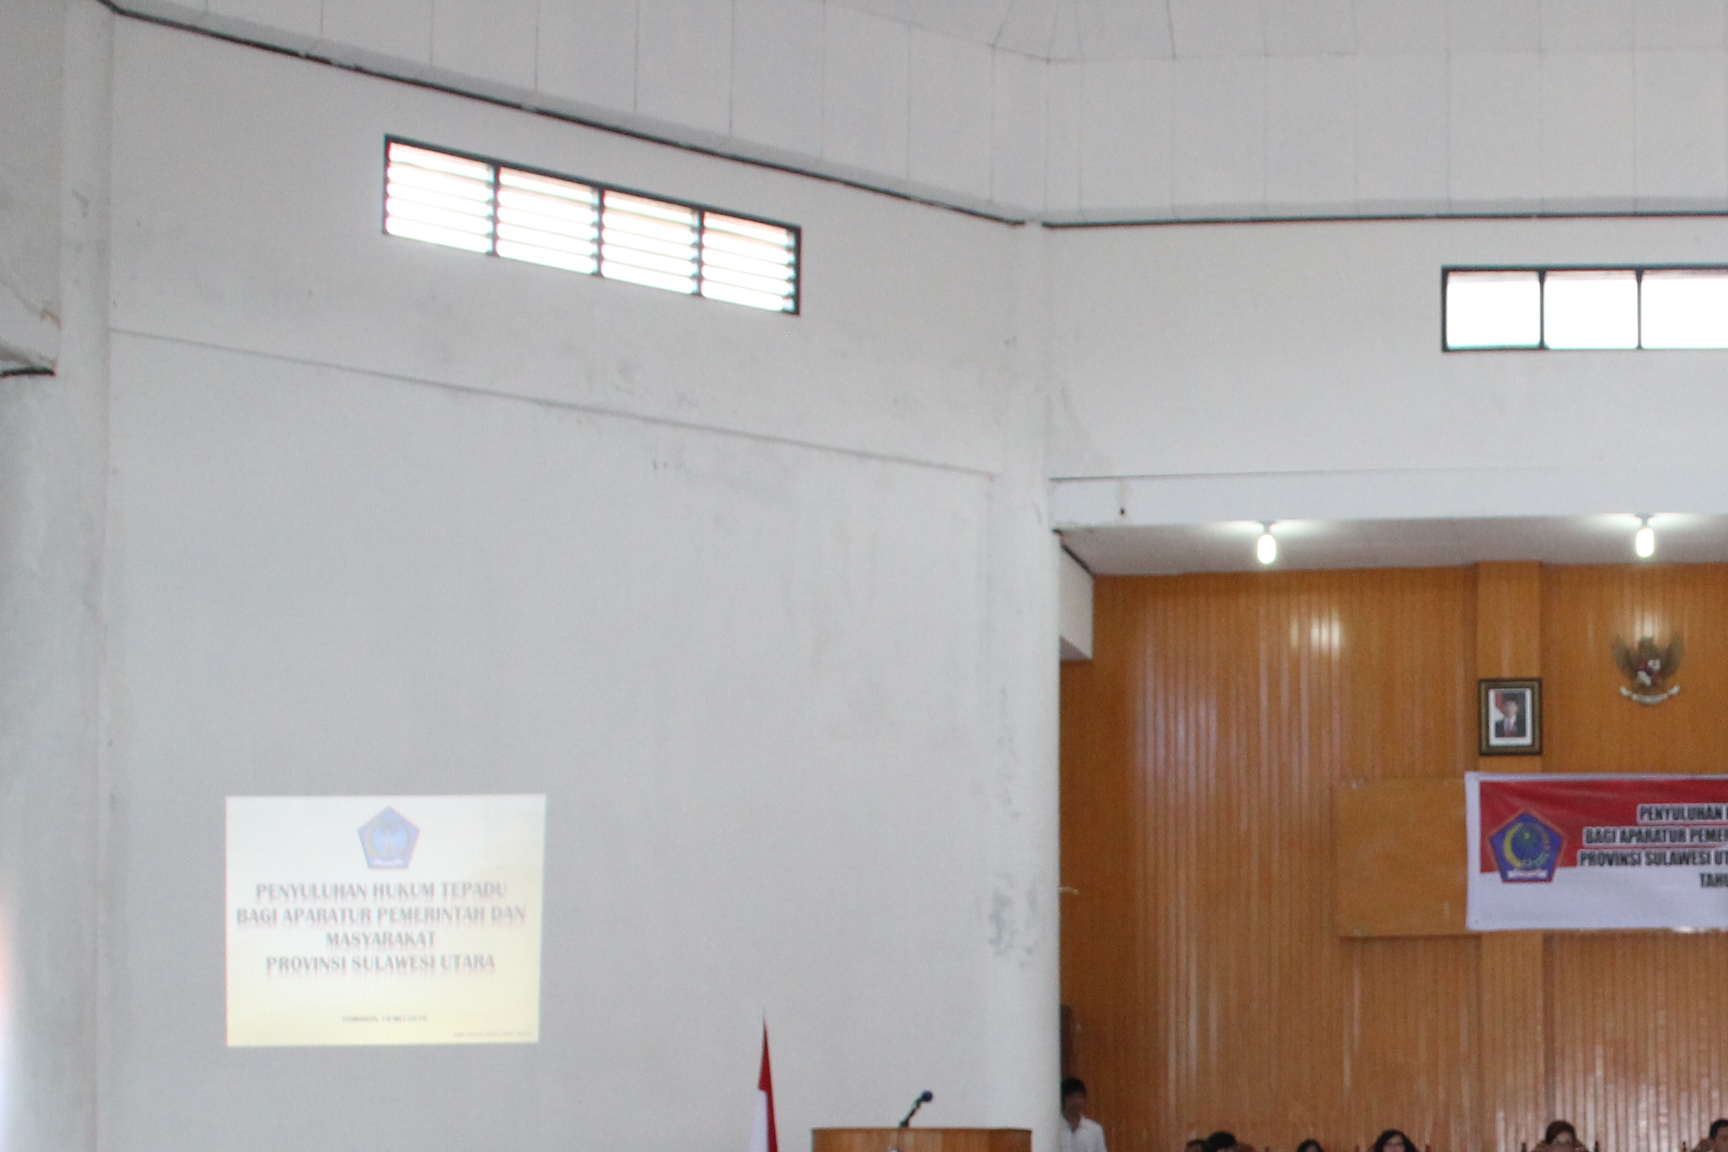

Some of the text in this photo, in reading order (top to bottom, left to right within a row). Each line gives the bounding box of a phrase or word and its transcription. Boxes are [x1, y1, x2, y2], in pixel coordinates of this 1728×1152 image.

[1639, 804, 1722, 822] PENYULUHAN
[1586, 828, 1616, 844] BAGI
[1620, 828, 1687, 844] APARATUR
[1580, 851, 1642, 866] PROVINSI
[1645, 851, 1711, 866] SULAWESI
[256, 881, 507, 899] PENYULUHAN HUKUM TEPADU
[236, 905, 526, 924] BAGI APARATUR PEMERINTAH DAN
[325, 931, 436, 946] MASYARAKAT
[266, 954, 496, 972] PROVINSI SULAWESI UTARA
